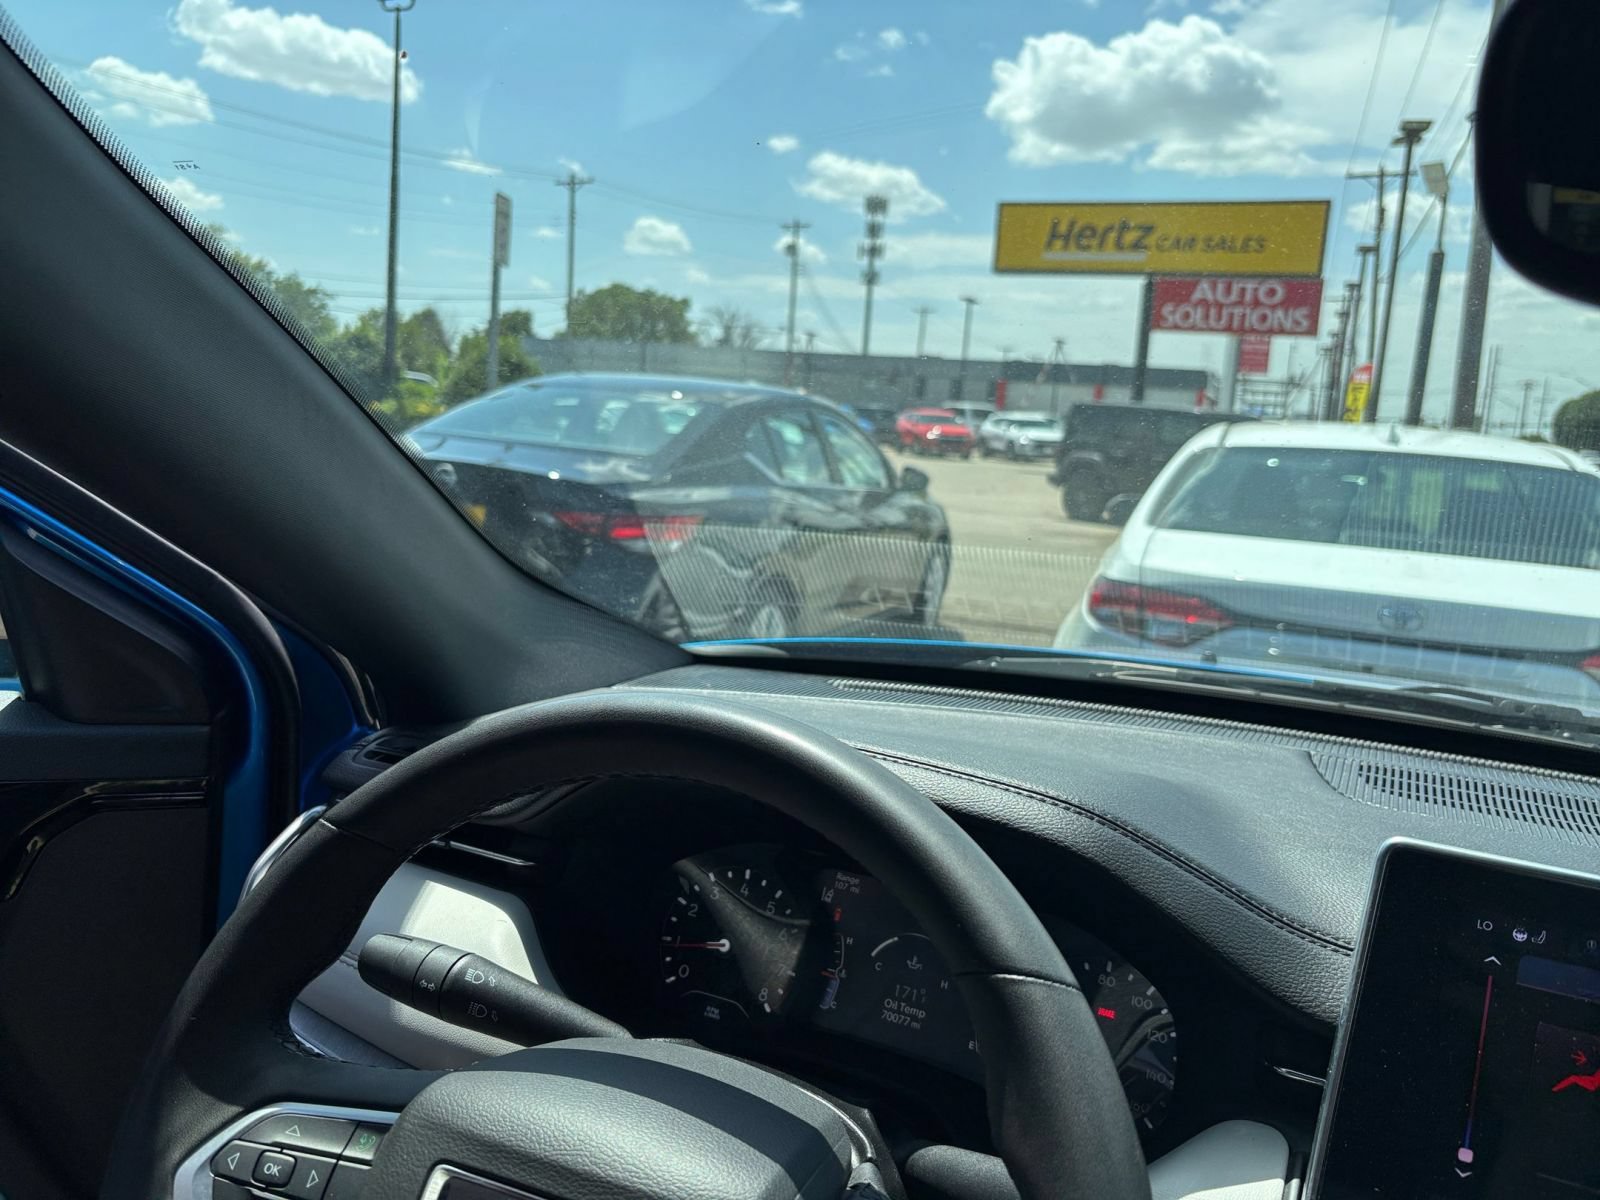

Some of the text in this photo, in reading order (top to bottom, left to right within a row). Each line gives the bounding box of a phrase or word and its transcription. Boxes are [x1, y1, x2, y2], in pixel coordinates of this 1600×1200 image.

[1045, 217, 1268, 254] Hertz CAR SALES
[1190, 279, 1284, 303] AUTO
[1161, 304, 1309, 331] SOLUTIONS
[710, 886, 720, 900] 3
[740, 883, 750, 897] 4
[688, 904, 698, 917] 2
[766, 901, 776, 916] 5
[1477, 919, 1493, 931] LO
[778, 928, 788, 941] 6
[678, 964, 690, 978] 0
[874, 962, 883, 971] C
[1098, 975, 1116, 988] 80
[759, 987, 768, 1001] 8
[884, 998, 927, 1019] Oil Temp
[1131, 996, 1153, 1010] 100
[881, 1009, 911, 1027] 70077
[263, 1162, 282, 1177] OK
